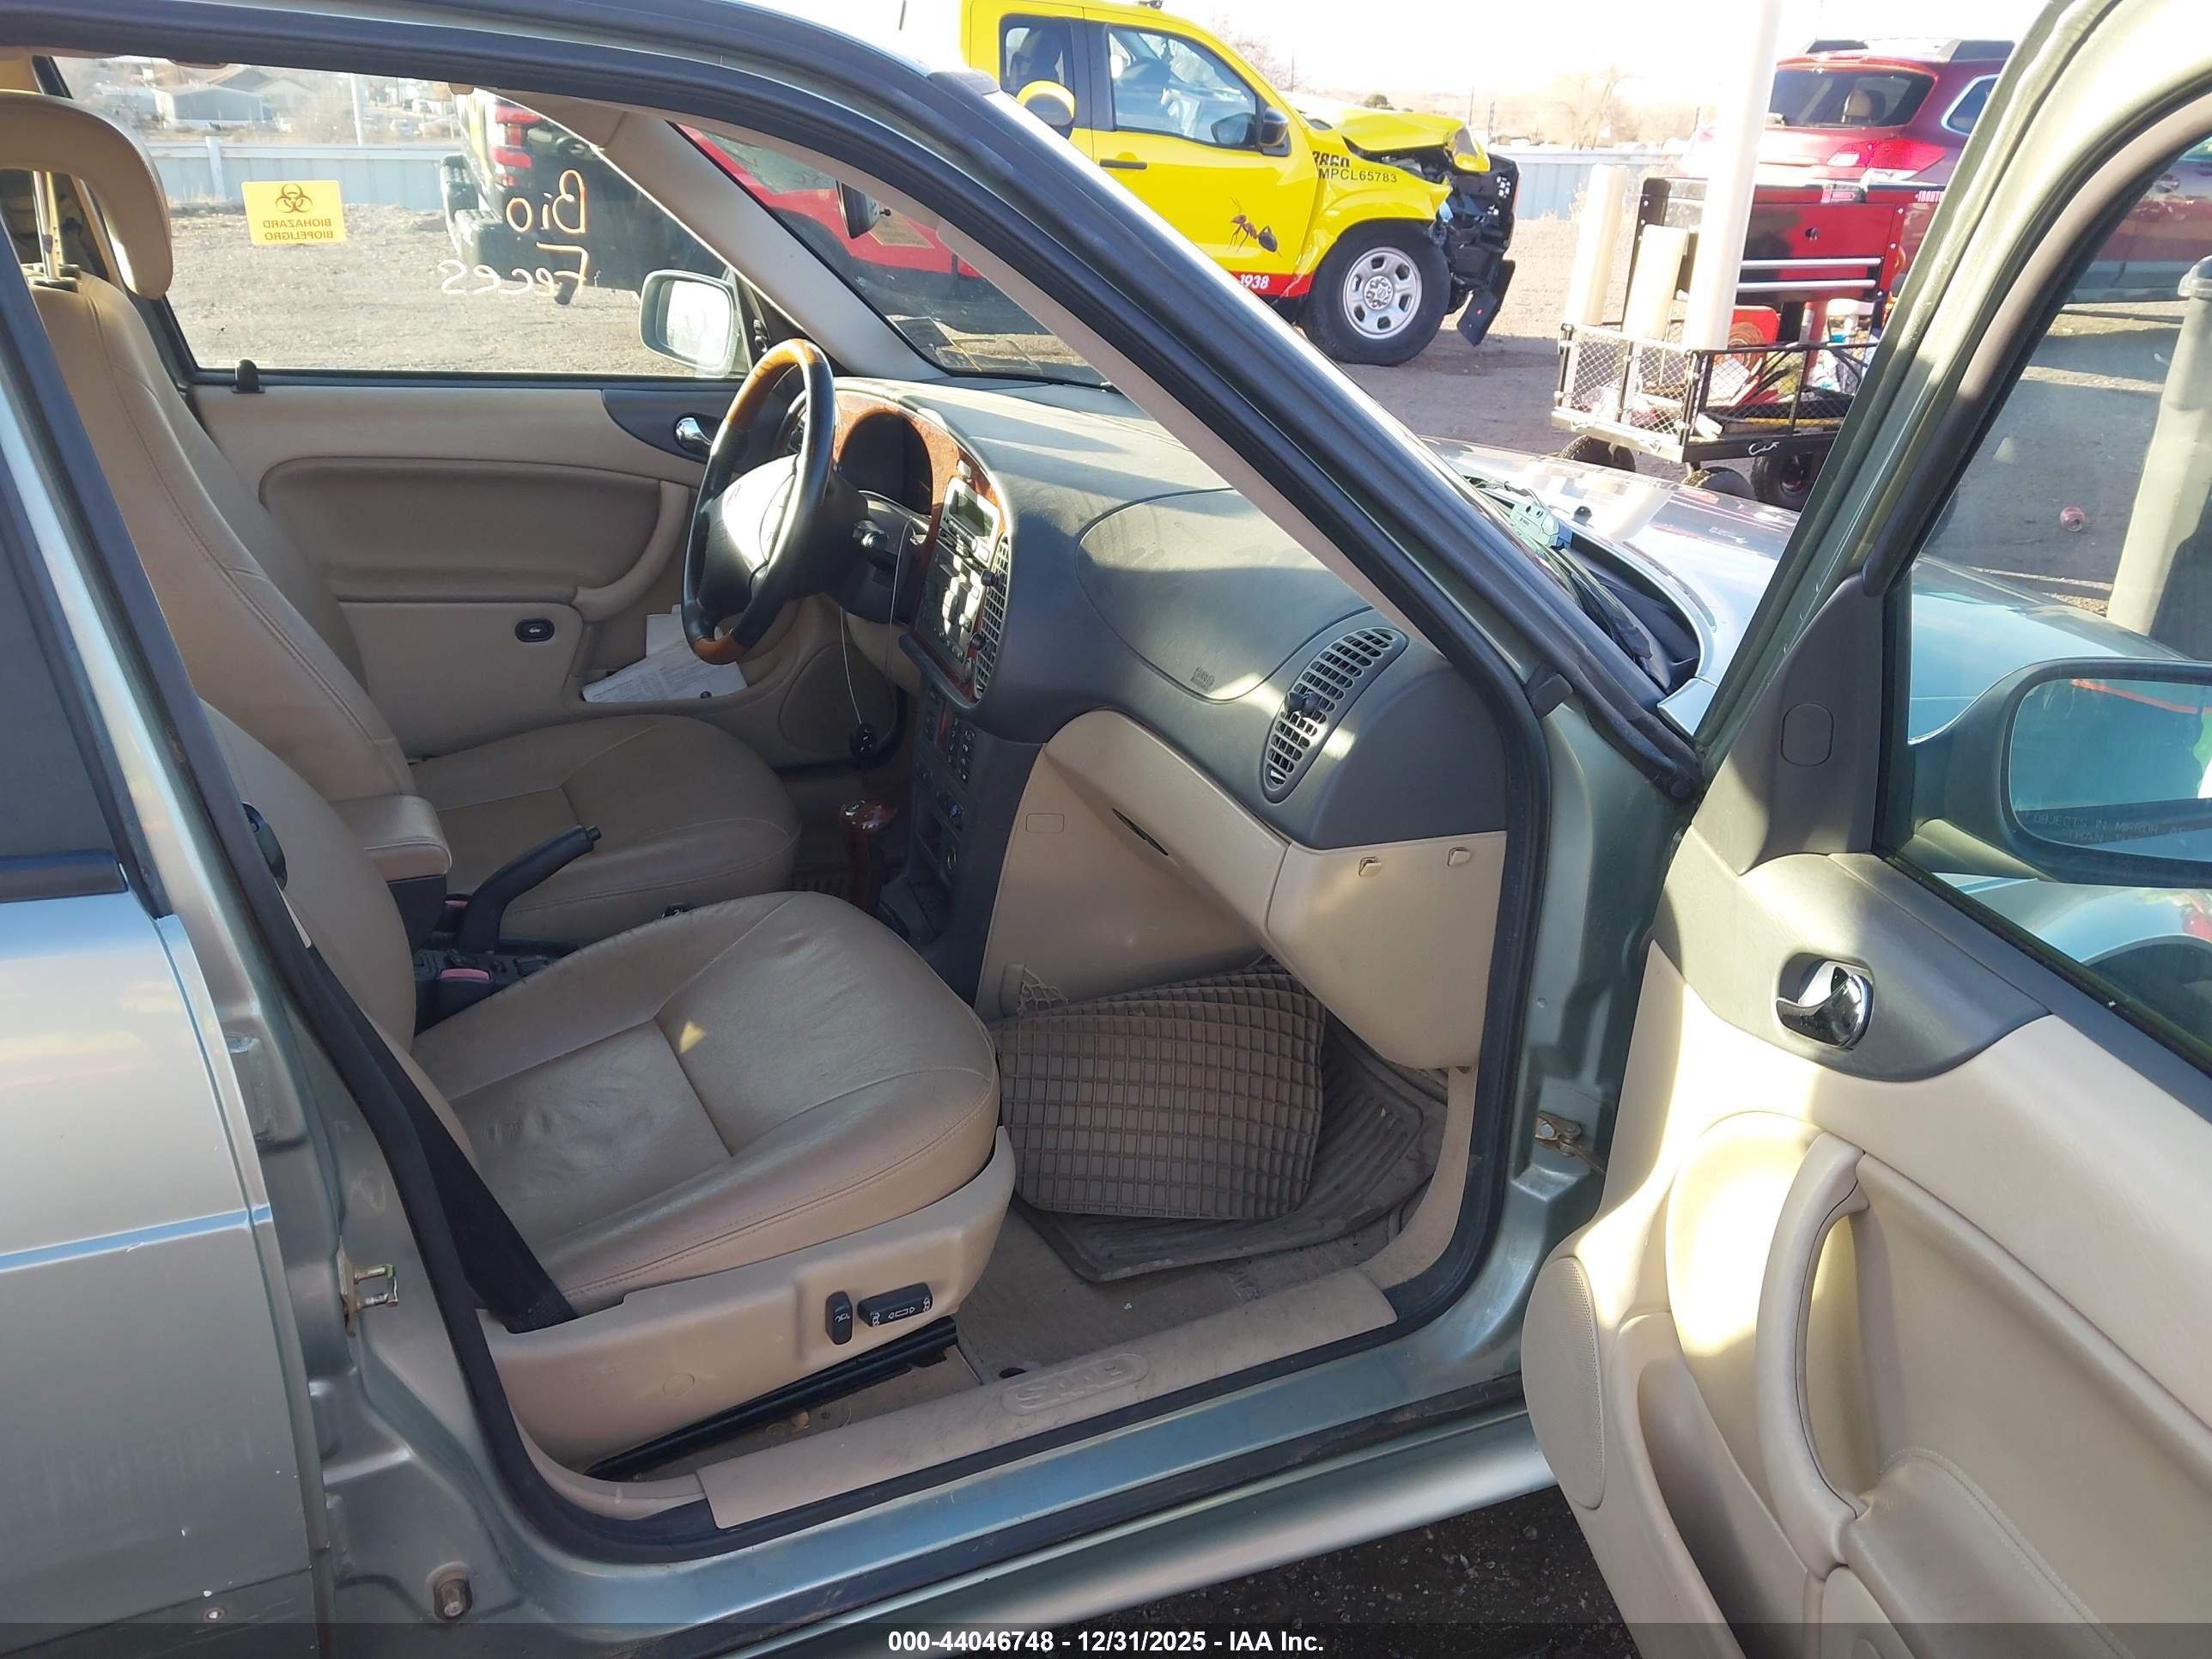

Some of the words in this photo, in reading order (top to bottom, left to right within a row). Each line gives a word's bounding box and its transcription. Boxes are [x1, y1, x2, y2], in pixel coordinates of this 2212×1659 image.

[1318, 168, 1398, 183] MPCL65783
[1240, 274, 1270, 289] 1938
[2033, 814, 2087, 827] OBJECTS
[2095, 818, 2107, 832] IN
[2115, 822, 2160, 835] MIRROR
[2068, 830, 2104, 842] THAN
[1014, 1358, 1132, 1410] SAAB
